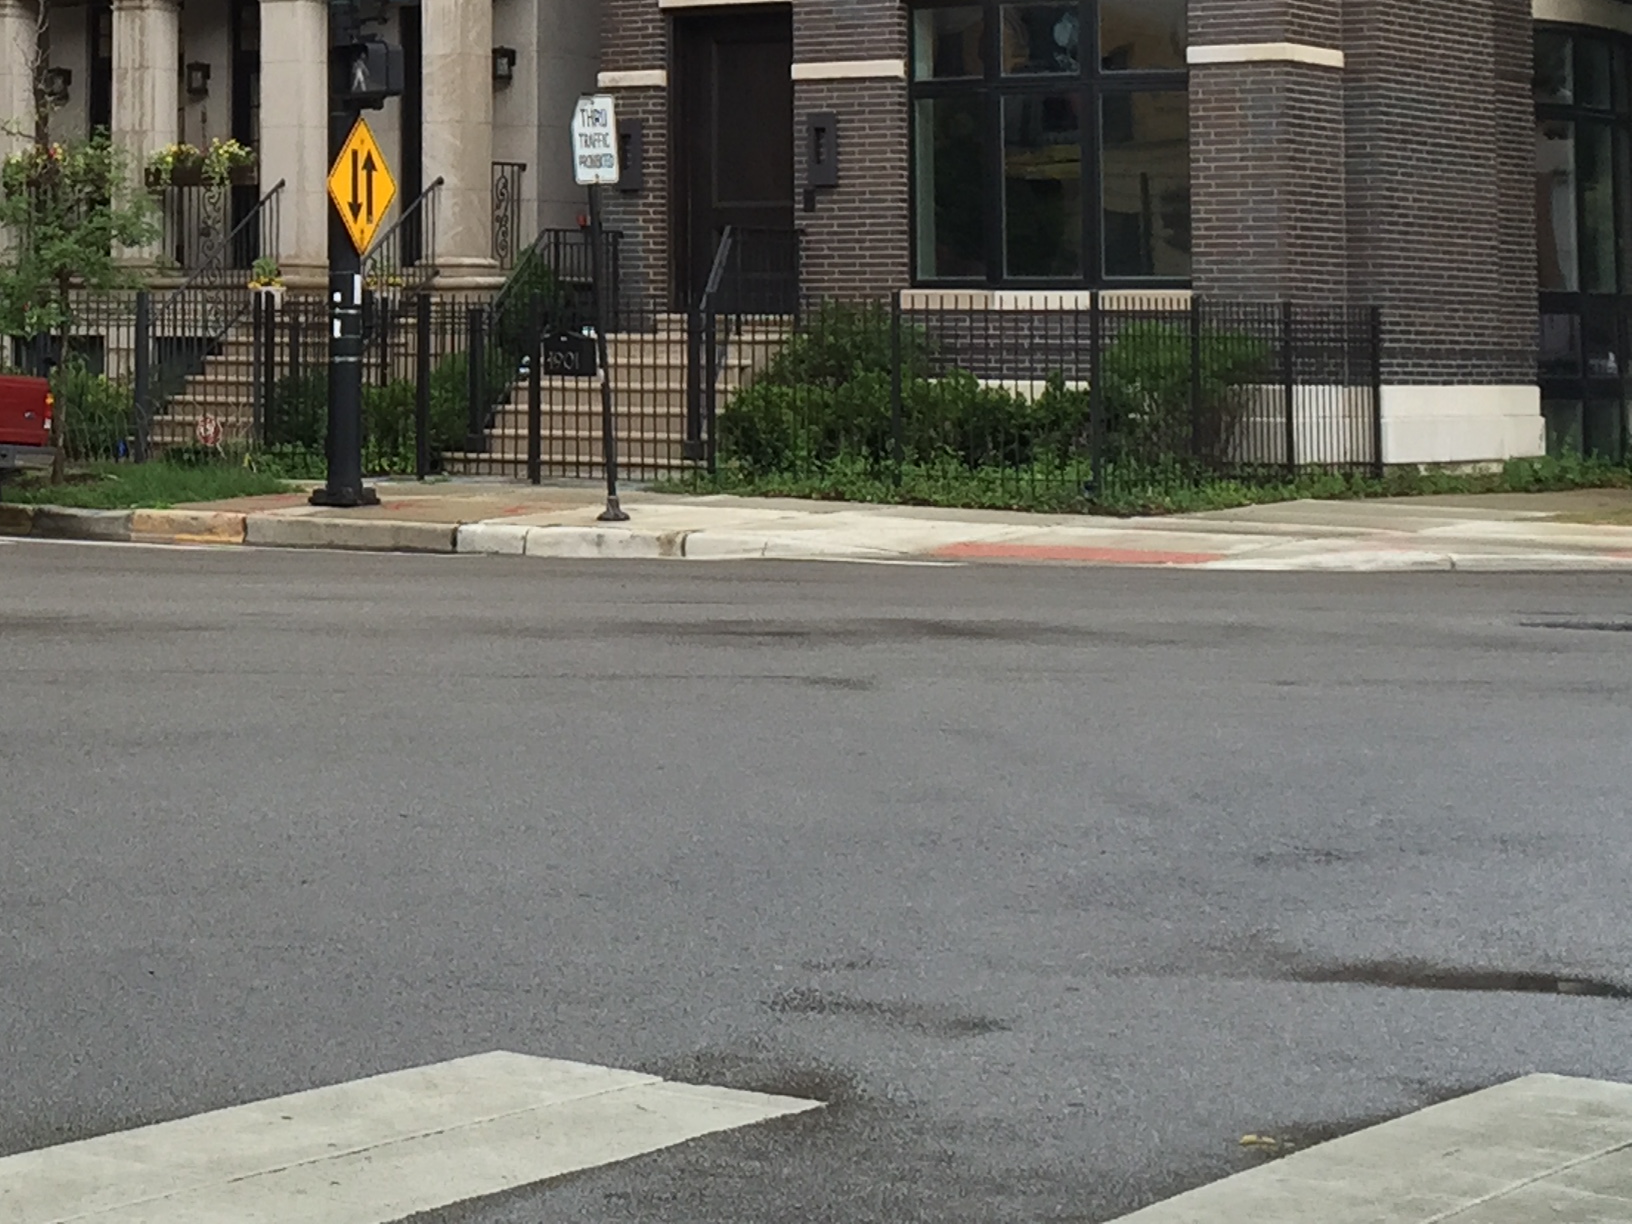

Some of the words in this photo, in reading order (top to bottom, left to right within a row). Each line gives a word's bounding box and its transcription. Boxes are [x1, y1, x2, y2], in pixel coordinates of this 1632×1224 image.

[579, 108, 608, 128] THRU
[577, 132, 611, 149] TRAFFIC
[578, 153, 614, 169] PROHIBITED
